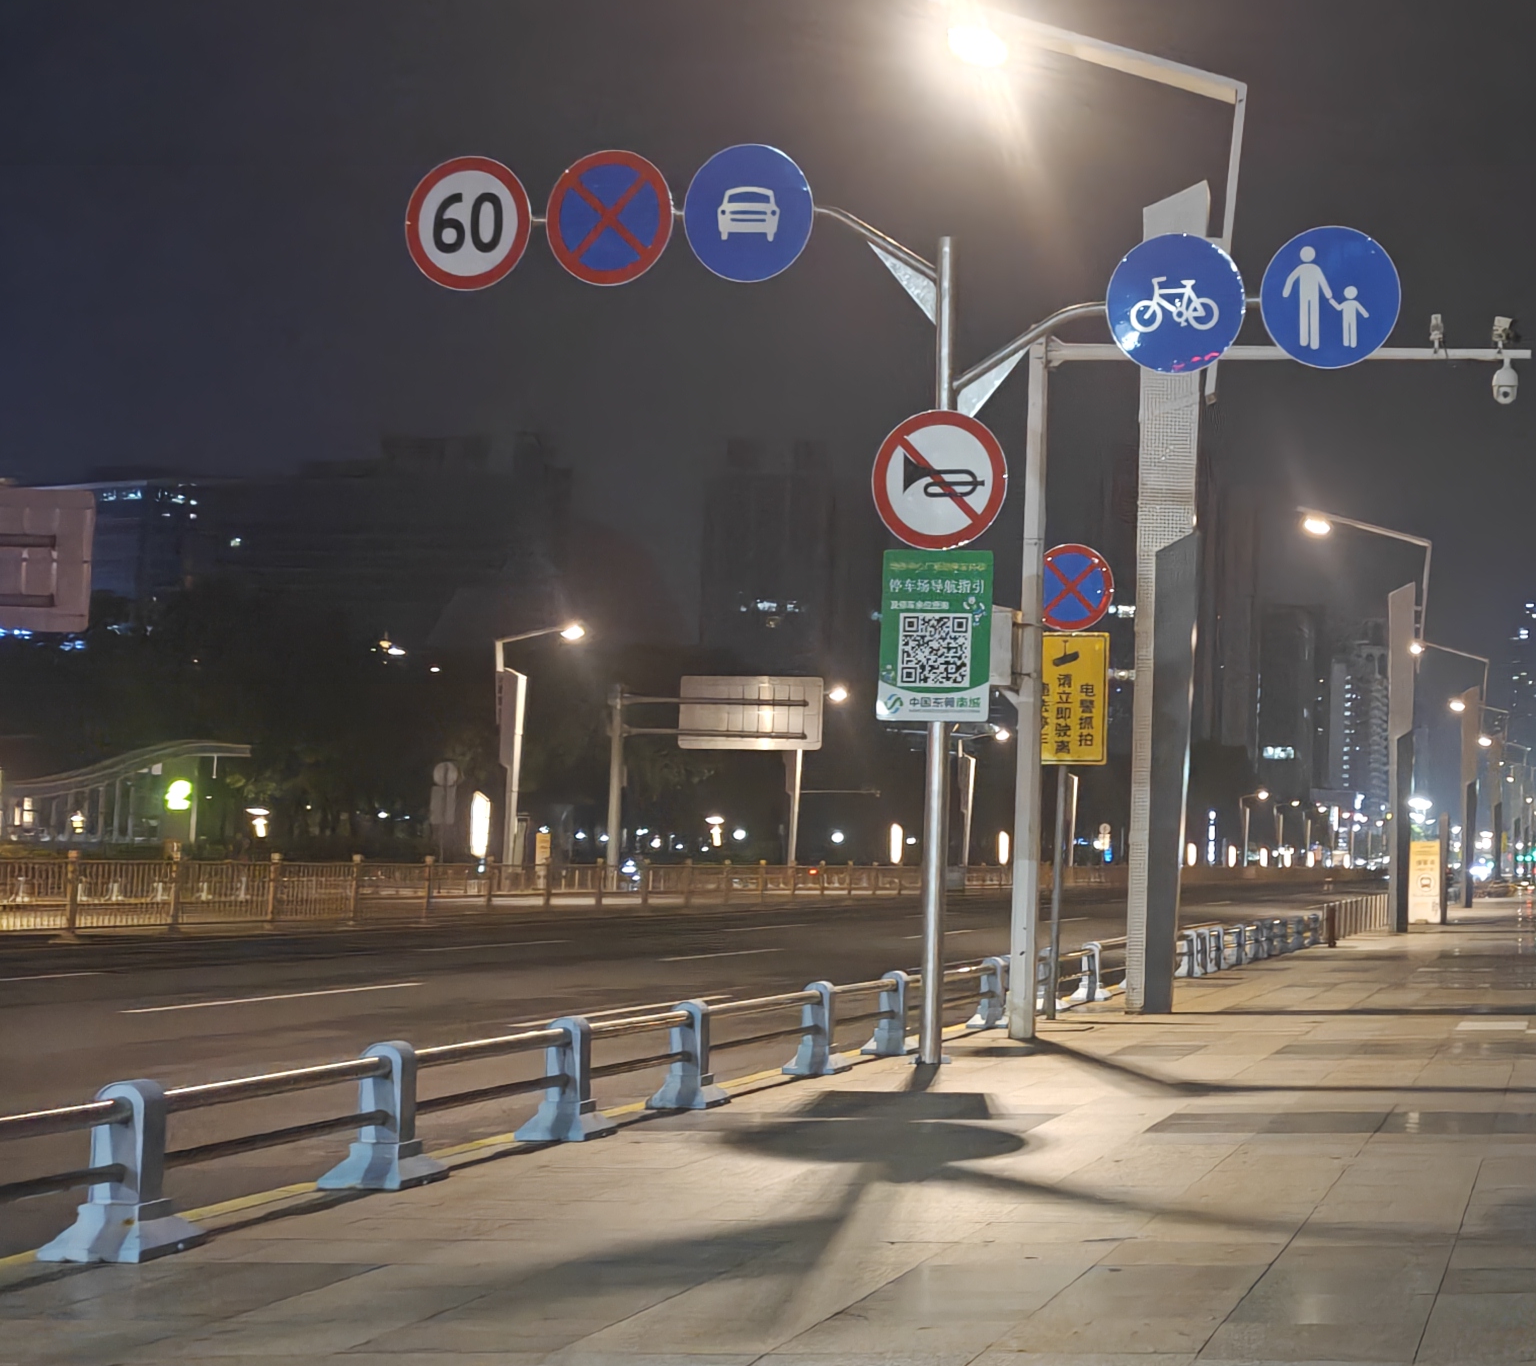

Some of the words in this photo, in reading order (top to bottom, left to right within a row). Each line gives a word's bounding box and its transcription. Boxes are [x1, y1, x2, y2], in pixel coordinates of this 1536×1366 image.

[433, 192, 503, 254] 60
[889, 578, 985, 594] 停车场导航指引
[909, 697, 981, 708] 中国东莞南城
[1054, 673, 1073, 755] 请立即驶离
[1078, 683, 1096, 747] 电警抓拍
